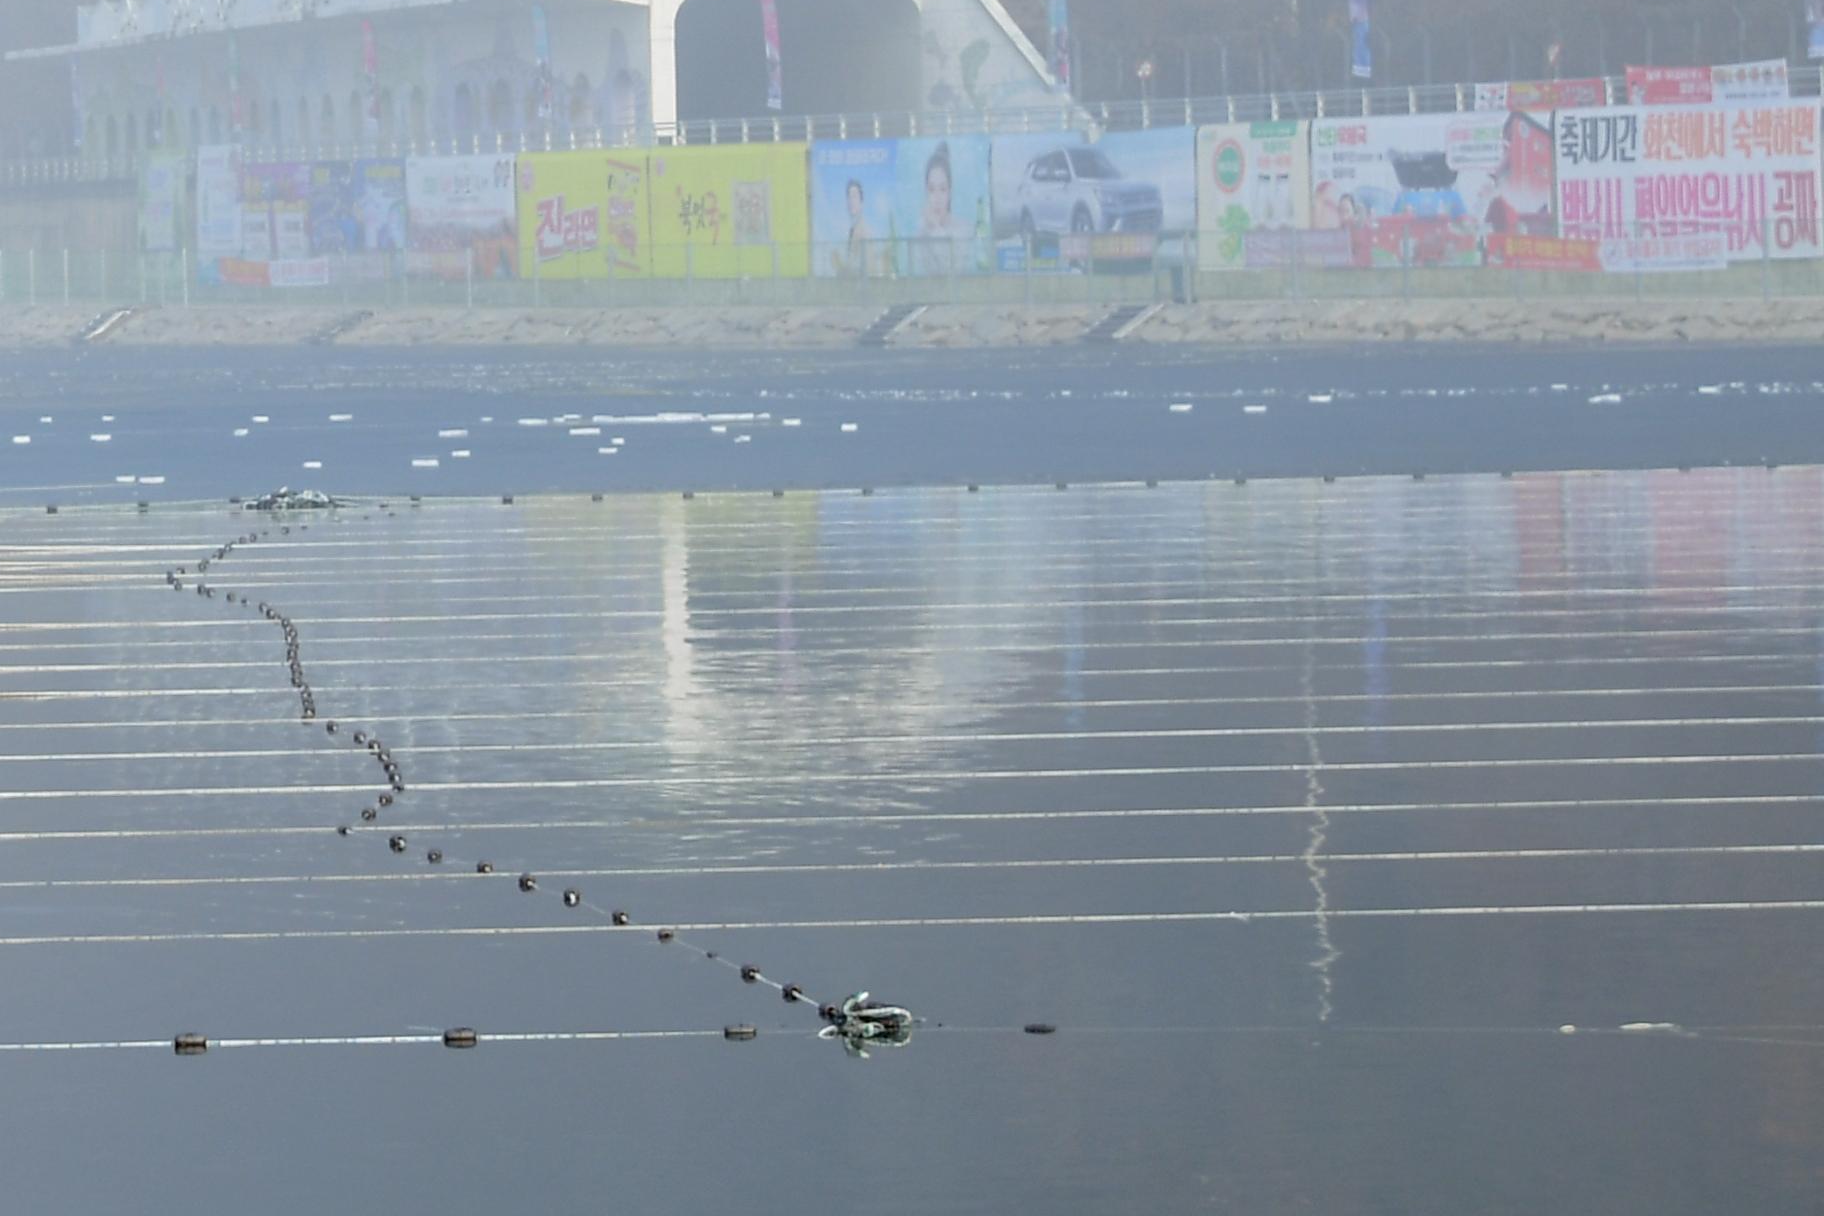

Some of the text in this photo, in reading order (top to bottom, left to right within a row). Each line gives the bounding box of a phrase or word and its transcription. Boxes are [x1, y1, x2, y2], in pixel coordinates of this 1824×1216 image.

[1560, 106, 1815, 164] 축제기간 화천에서 숙박하면
[1772, 171, 1818, 250] 공짜
